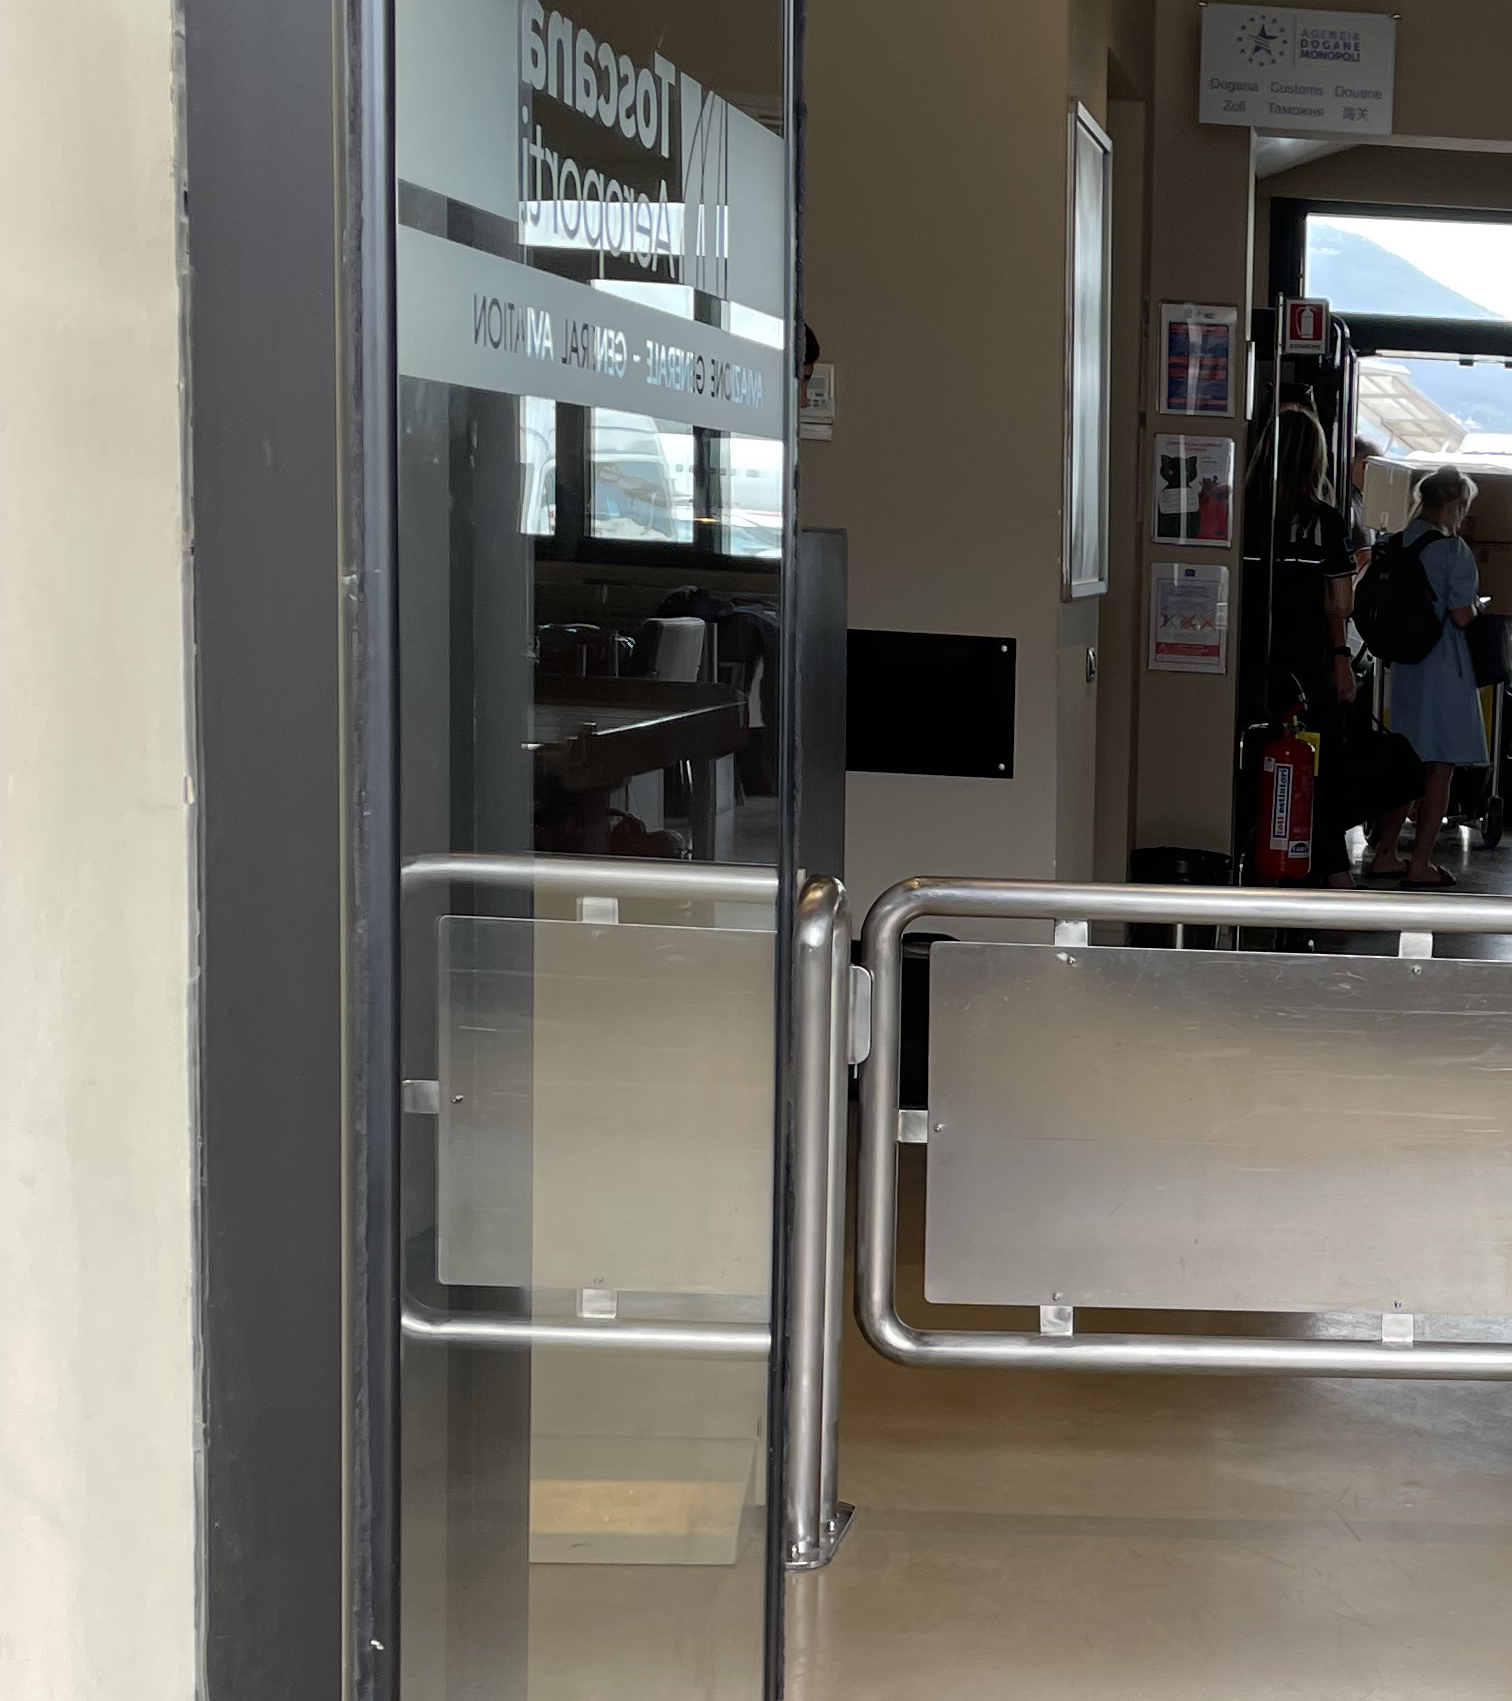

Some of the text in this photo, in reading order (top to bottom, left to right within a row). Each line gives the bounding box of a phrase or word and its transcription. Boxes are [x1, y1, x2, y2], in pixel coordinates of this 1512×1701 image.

[1301, 29, 1361, 41] AGENZIA
[1300, 39, 1361, 51] DOGANE
[1300, 50, 1361, 62] MONOPOLI
[1210, 77, 1383, 100] Dogana Customs Douane
[1223, 100, 1246, 112] Zoll
